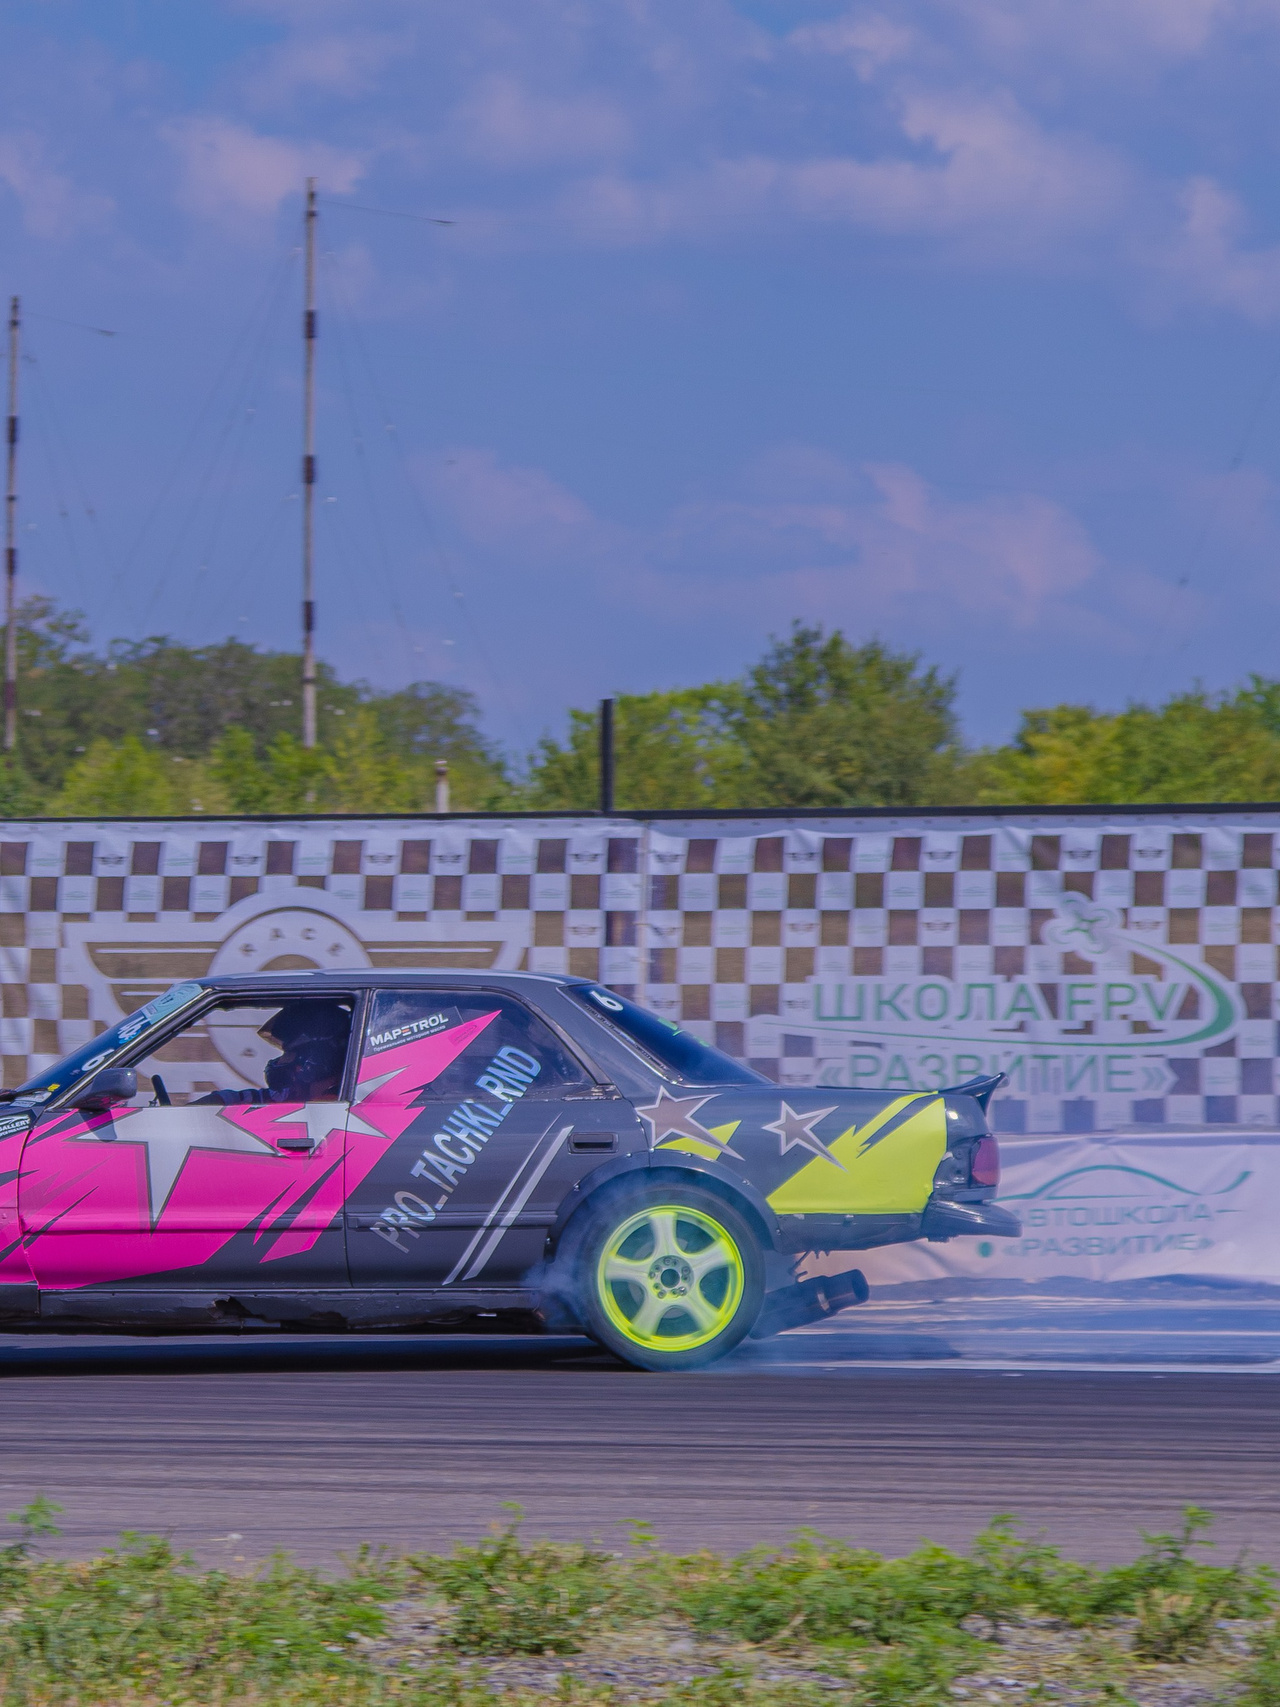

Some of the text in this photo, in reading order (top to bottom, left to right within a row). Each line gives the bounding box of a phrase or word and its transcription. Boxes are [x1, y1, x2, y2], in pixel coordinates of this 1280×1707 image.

[813, 982, 1180, 1022] ШКОЛА FPV
[370, 1013, 449, 1047] MAPETROL
